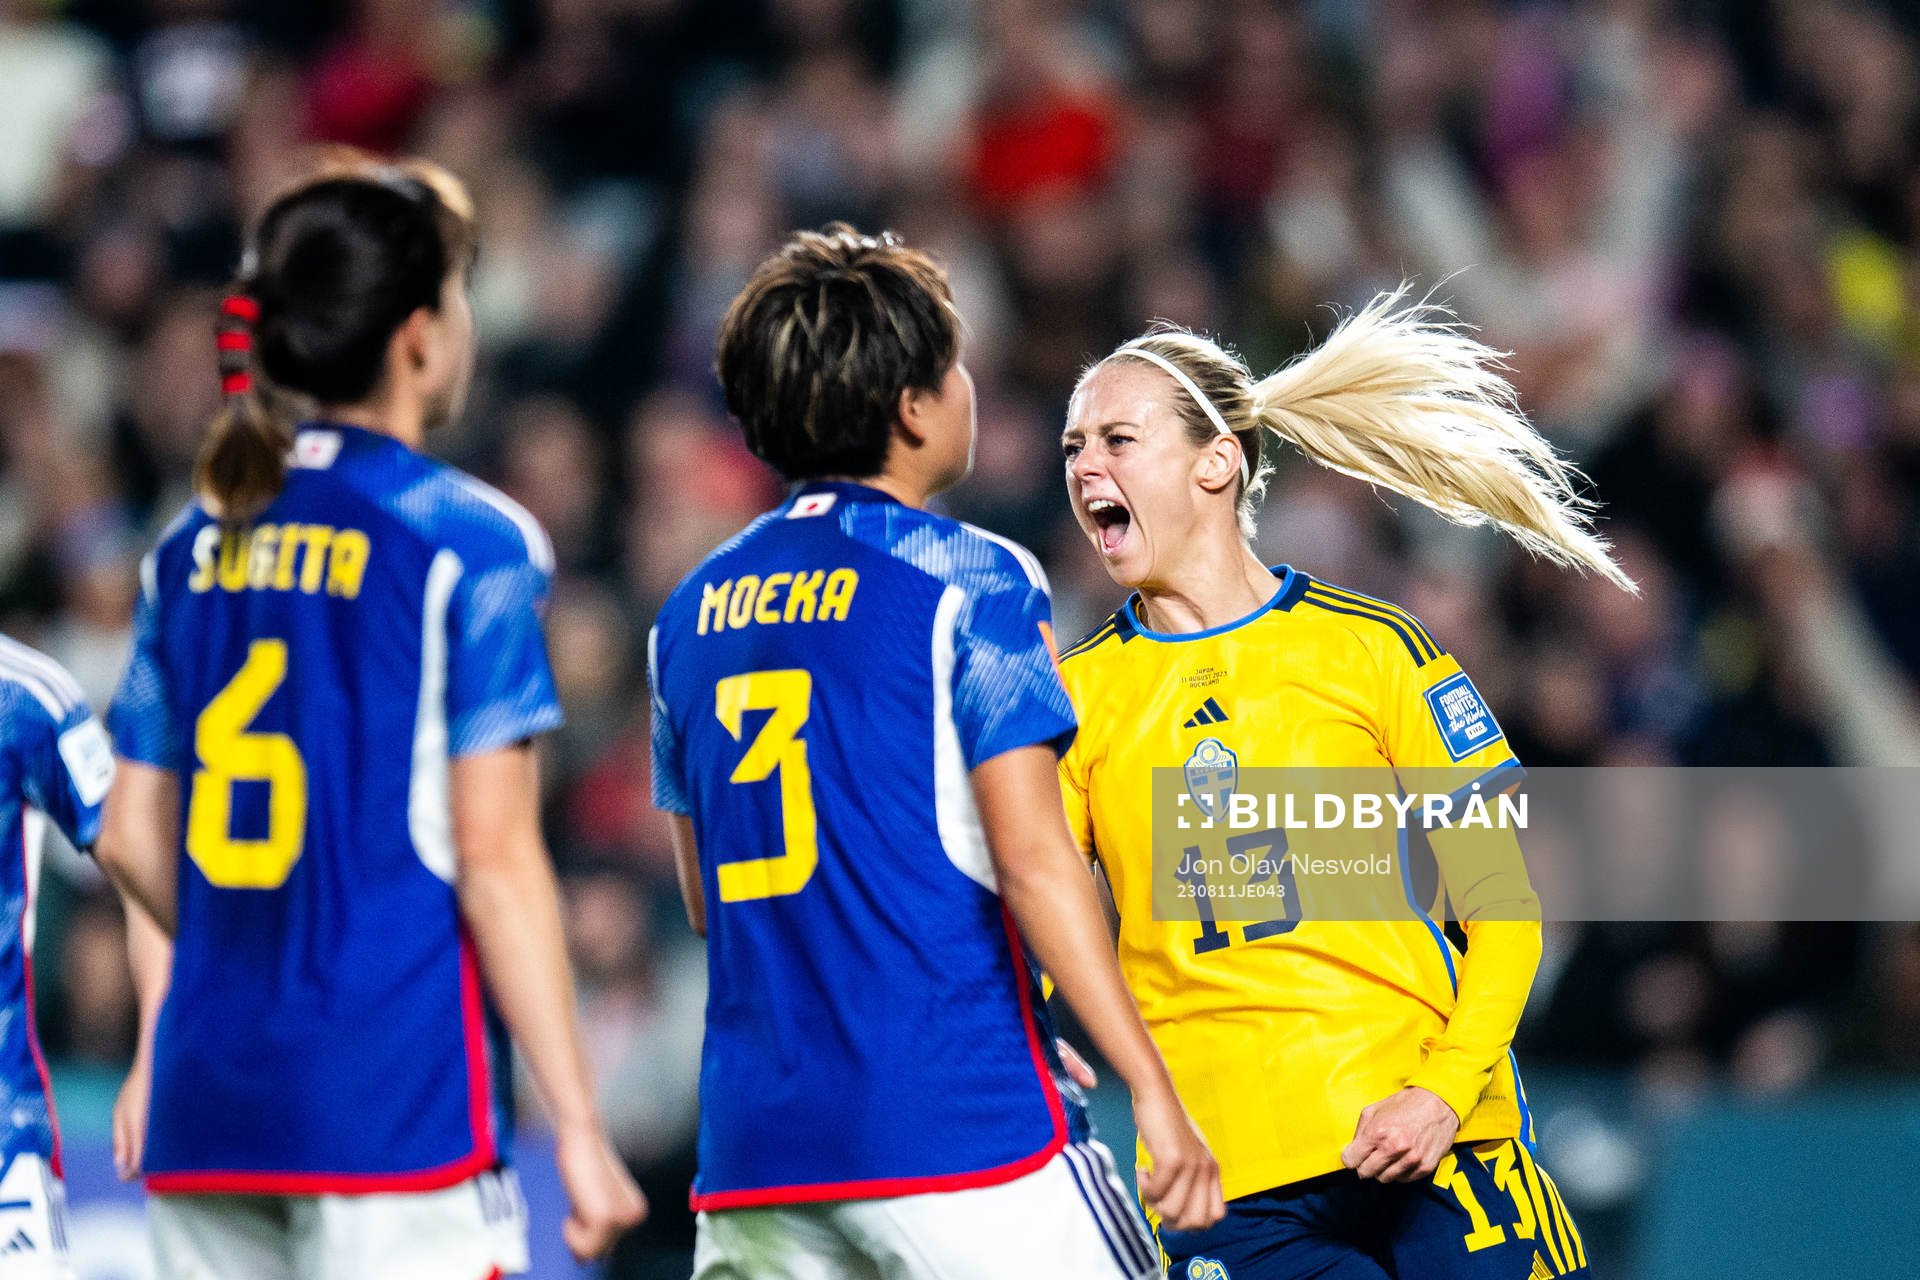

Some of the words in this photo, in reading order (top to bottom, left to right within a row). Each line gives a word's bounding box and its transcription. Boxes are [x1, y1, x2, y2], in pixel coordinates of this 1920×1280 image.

[188, 523, 371, 600] SUGITA
[697, 568, 859, 635] MOEKA
[1439, 684, 1471, 708] FOOTBALL
[1443, 693, 1479, 721] UNITES
[1448, 716, 1466, 733] the
[1463, 705, 1487, 726] World
[187, 638, 307, 890] 6
[715, 668, 818, 903] 3
[1173, 827, 1303, 955] 13
